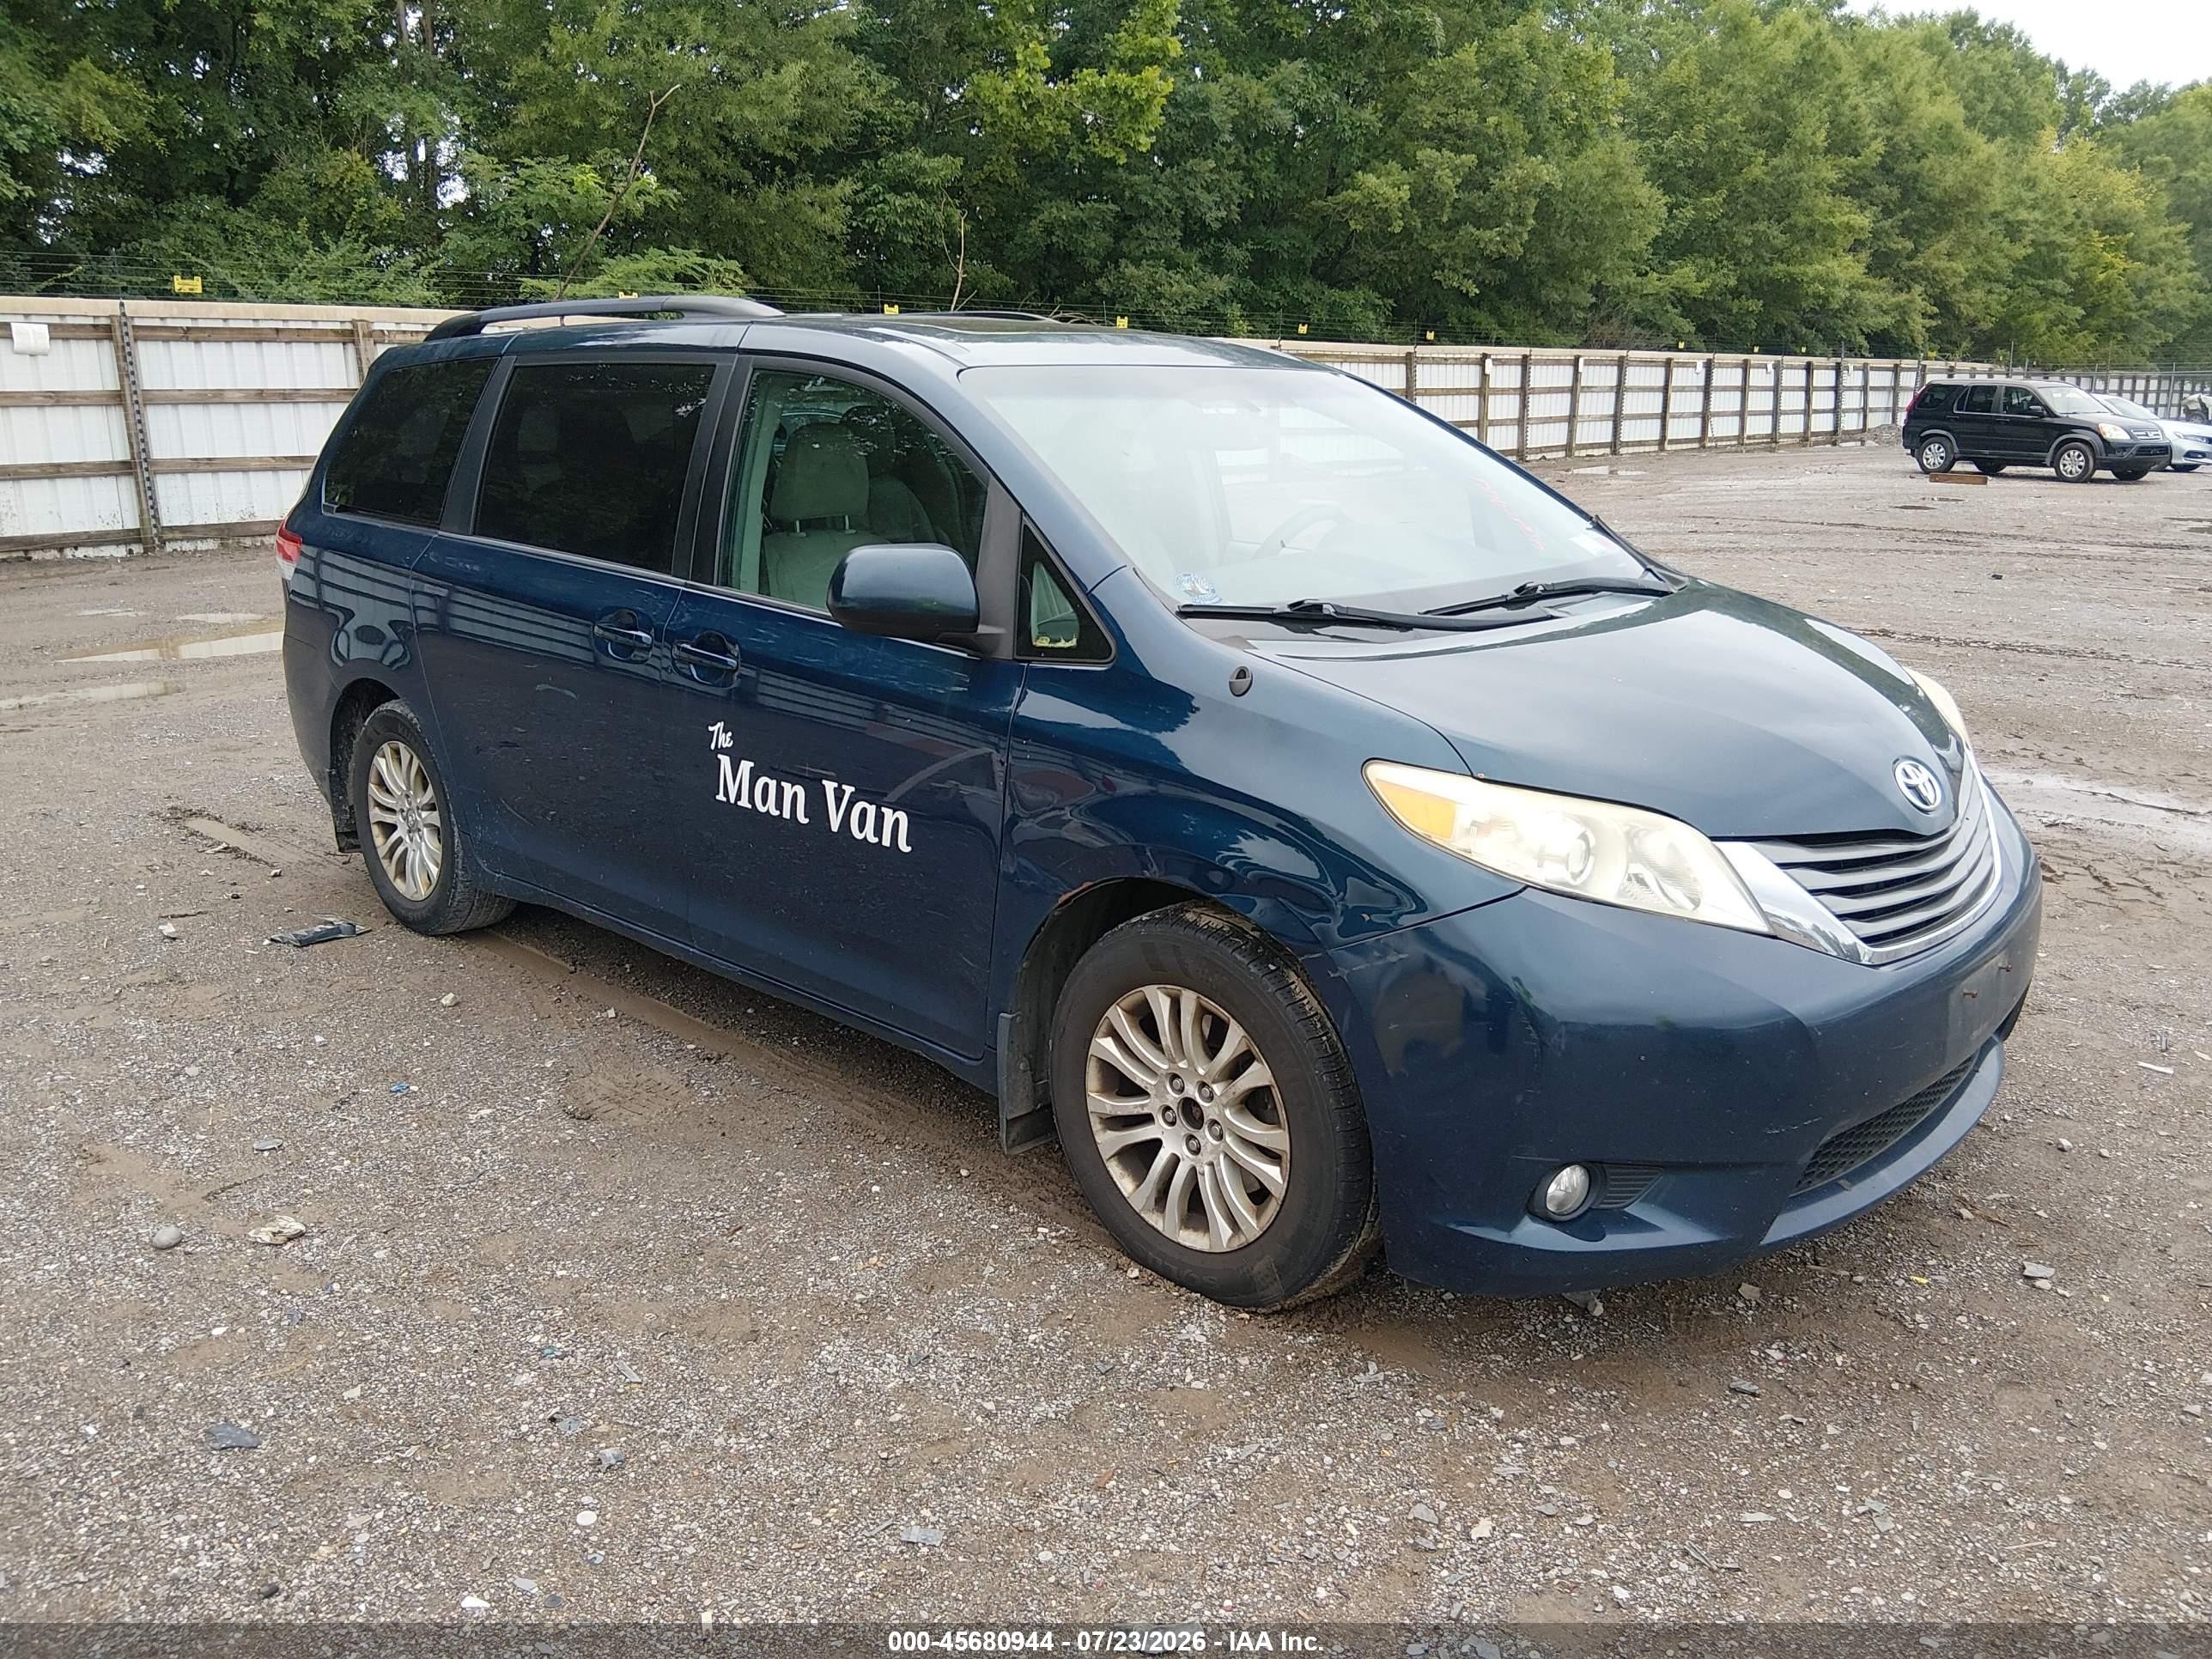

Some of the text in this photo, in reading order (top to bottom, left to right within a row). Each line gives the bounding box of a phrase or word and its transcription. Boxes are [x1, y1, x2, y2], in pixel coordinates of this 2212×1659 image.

[708, 721, 733, 750] The
[715, 754, 913, 853] Man Van
